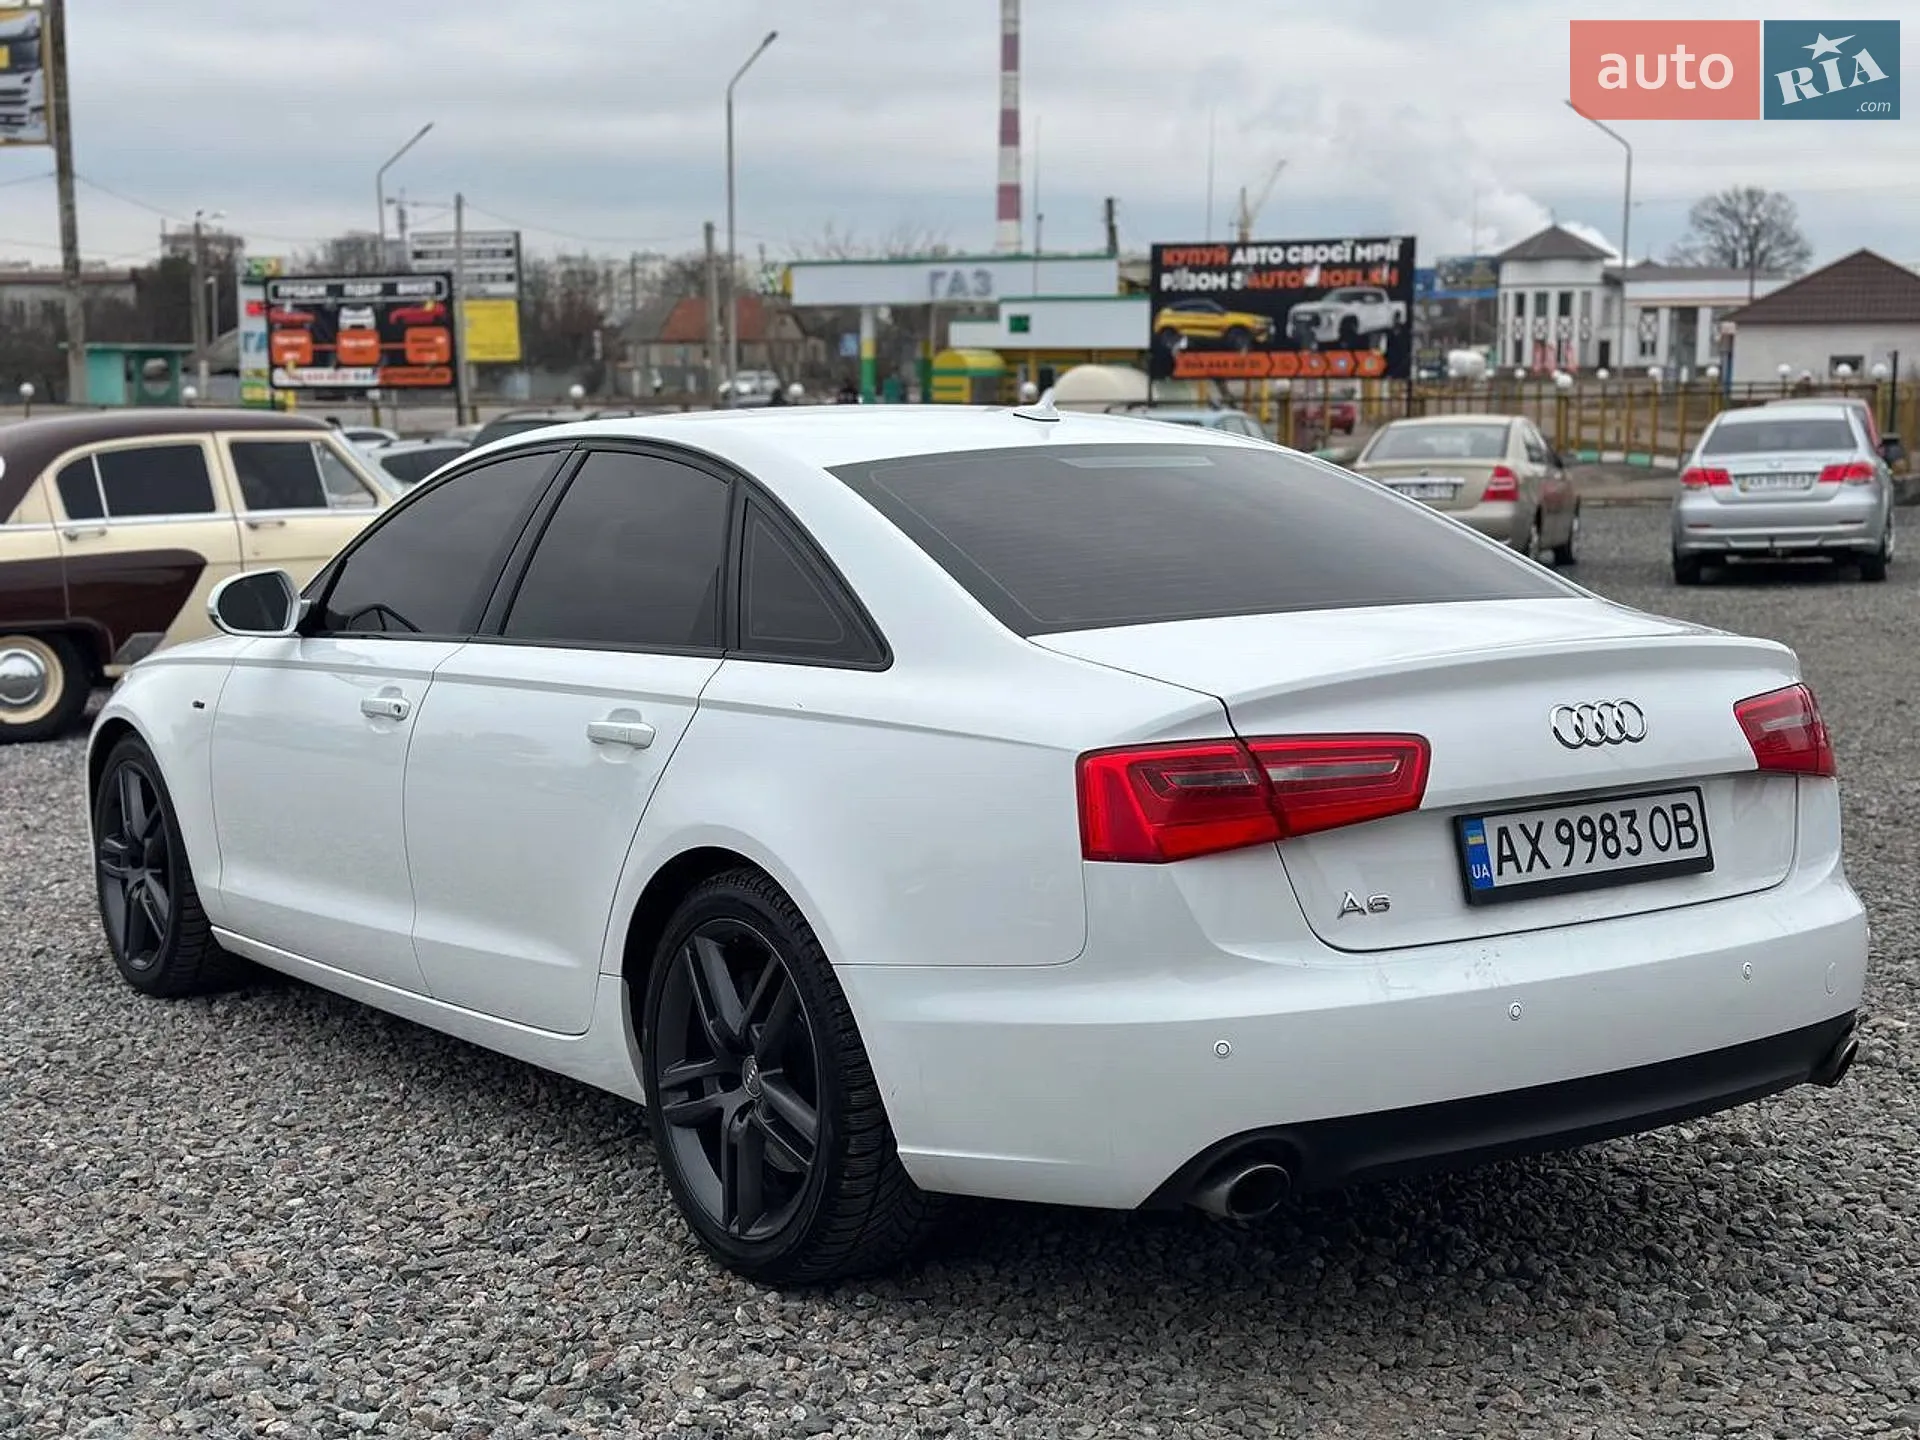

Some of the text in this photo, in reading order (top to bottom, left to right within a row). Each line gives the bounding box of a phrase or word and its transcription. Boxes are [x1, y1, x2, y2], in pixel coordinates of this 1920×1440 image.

[1231, 246, 1285, 265] АВТО
[929, 269, 993, 297] ГАЗ
[1496, 802, 1698, 877] AX 9983 OB
[1472, 862, 1491, 880] UA
[1337, 889, 1391, 919] A6
